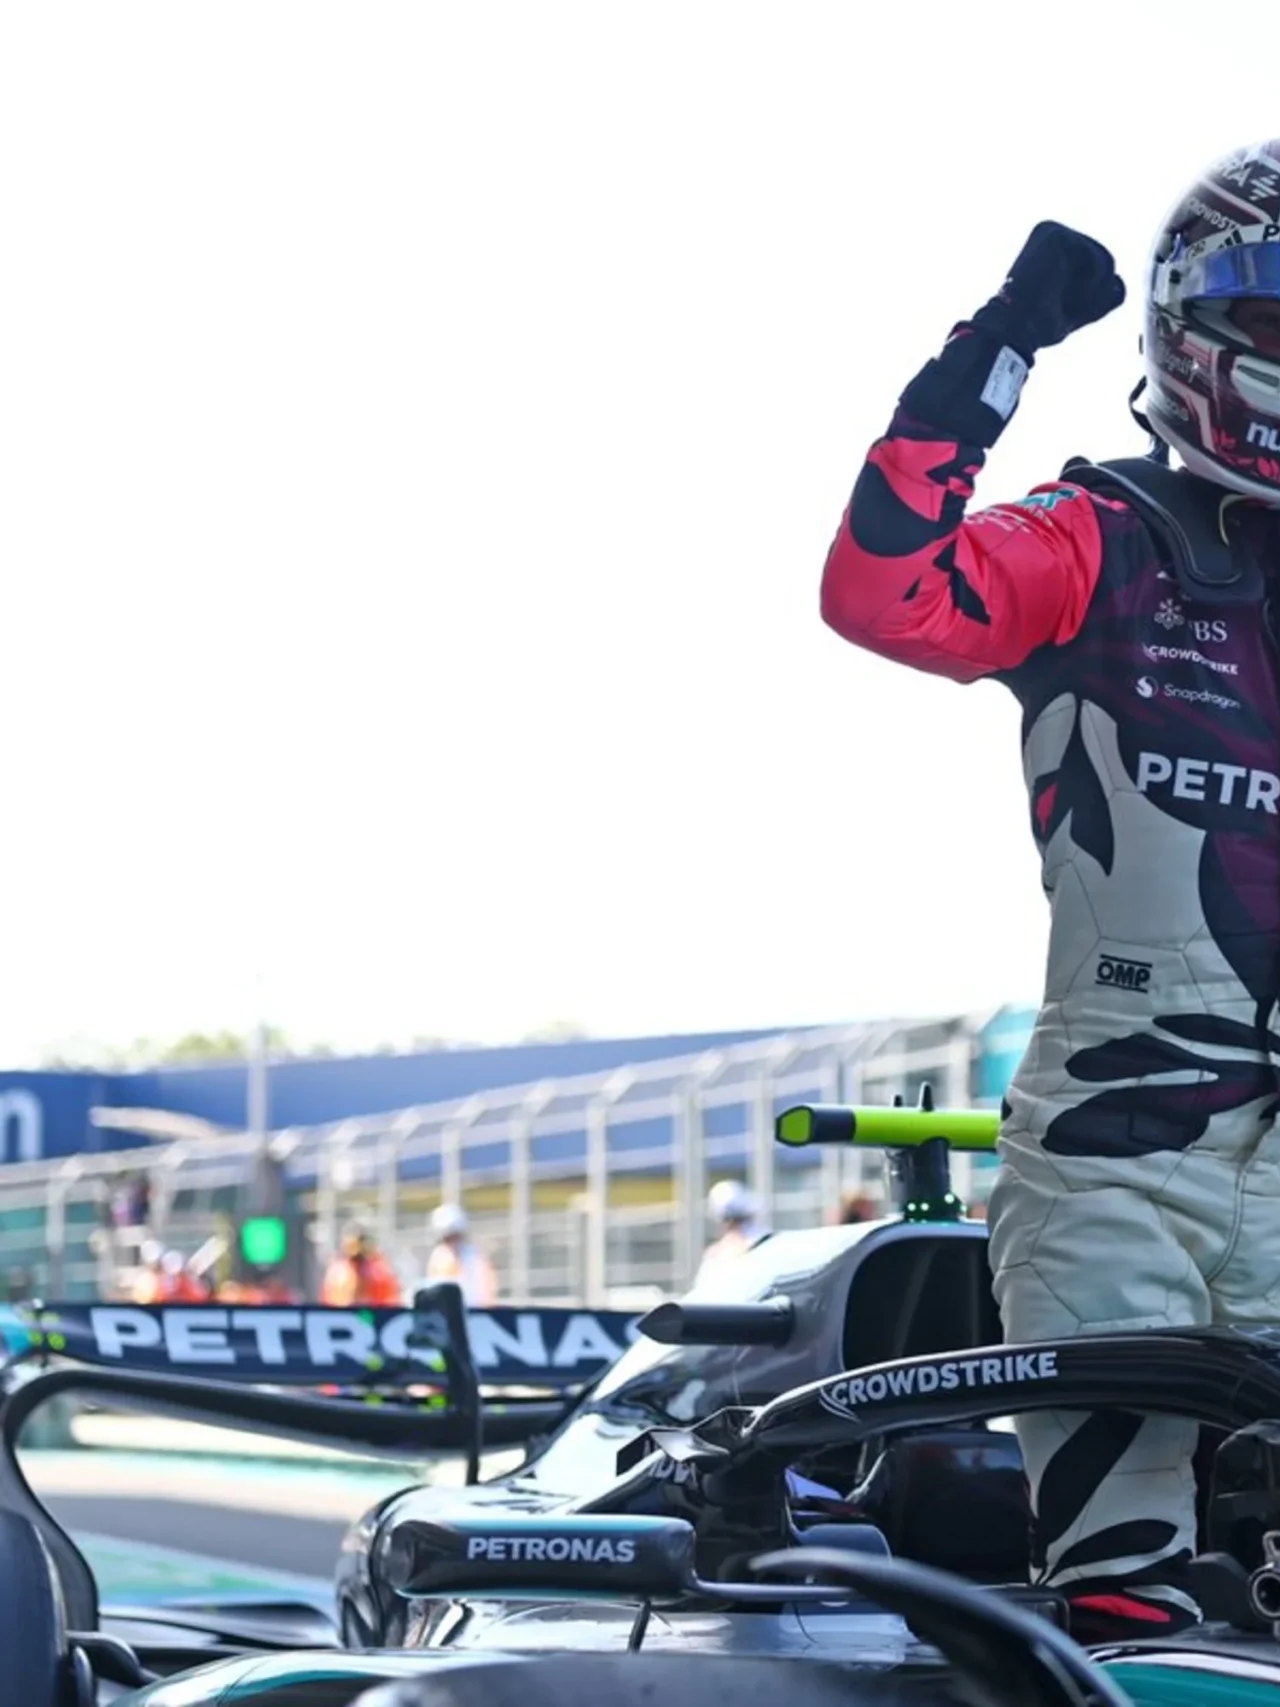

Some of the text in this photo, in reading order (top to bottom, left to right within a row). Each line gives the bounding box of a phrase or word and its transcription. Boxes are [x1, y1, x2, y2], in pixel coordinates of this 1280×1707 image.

[1187, 619, 1228, 643] BS
[1163, 683, 1241, 709] Snapdragon
[1096, 957, 1151, 990] OMP
[91, 1307, 640, 1367] PETRONA
[829, 1351, 1059, 1406] CROWDSTRIKE
[467, 1537, 636, 1563] PETRONAS
